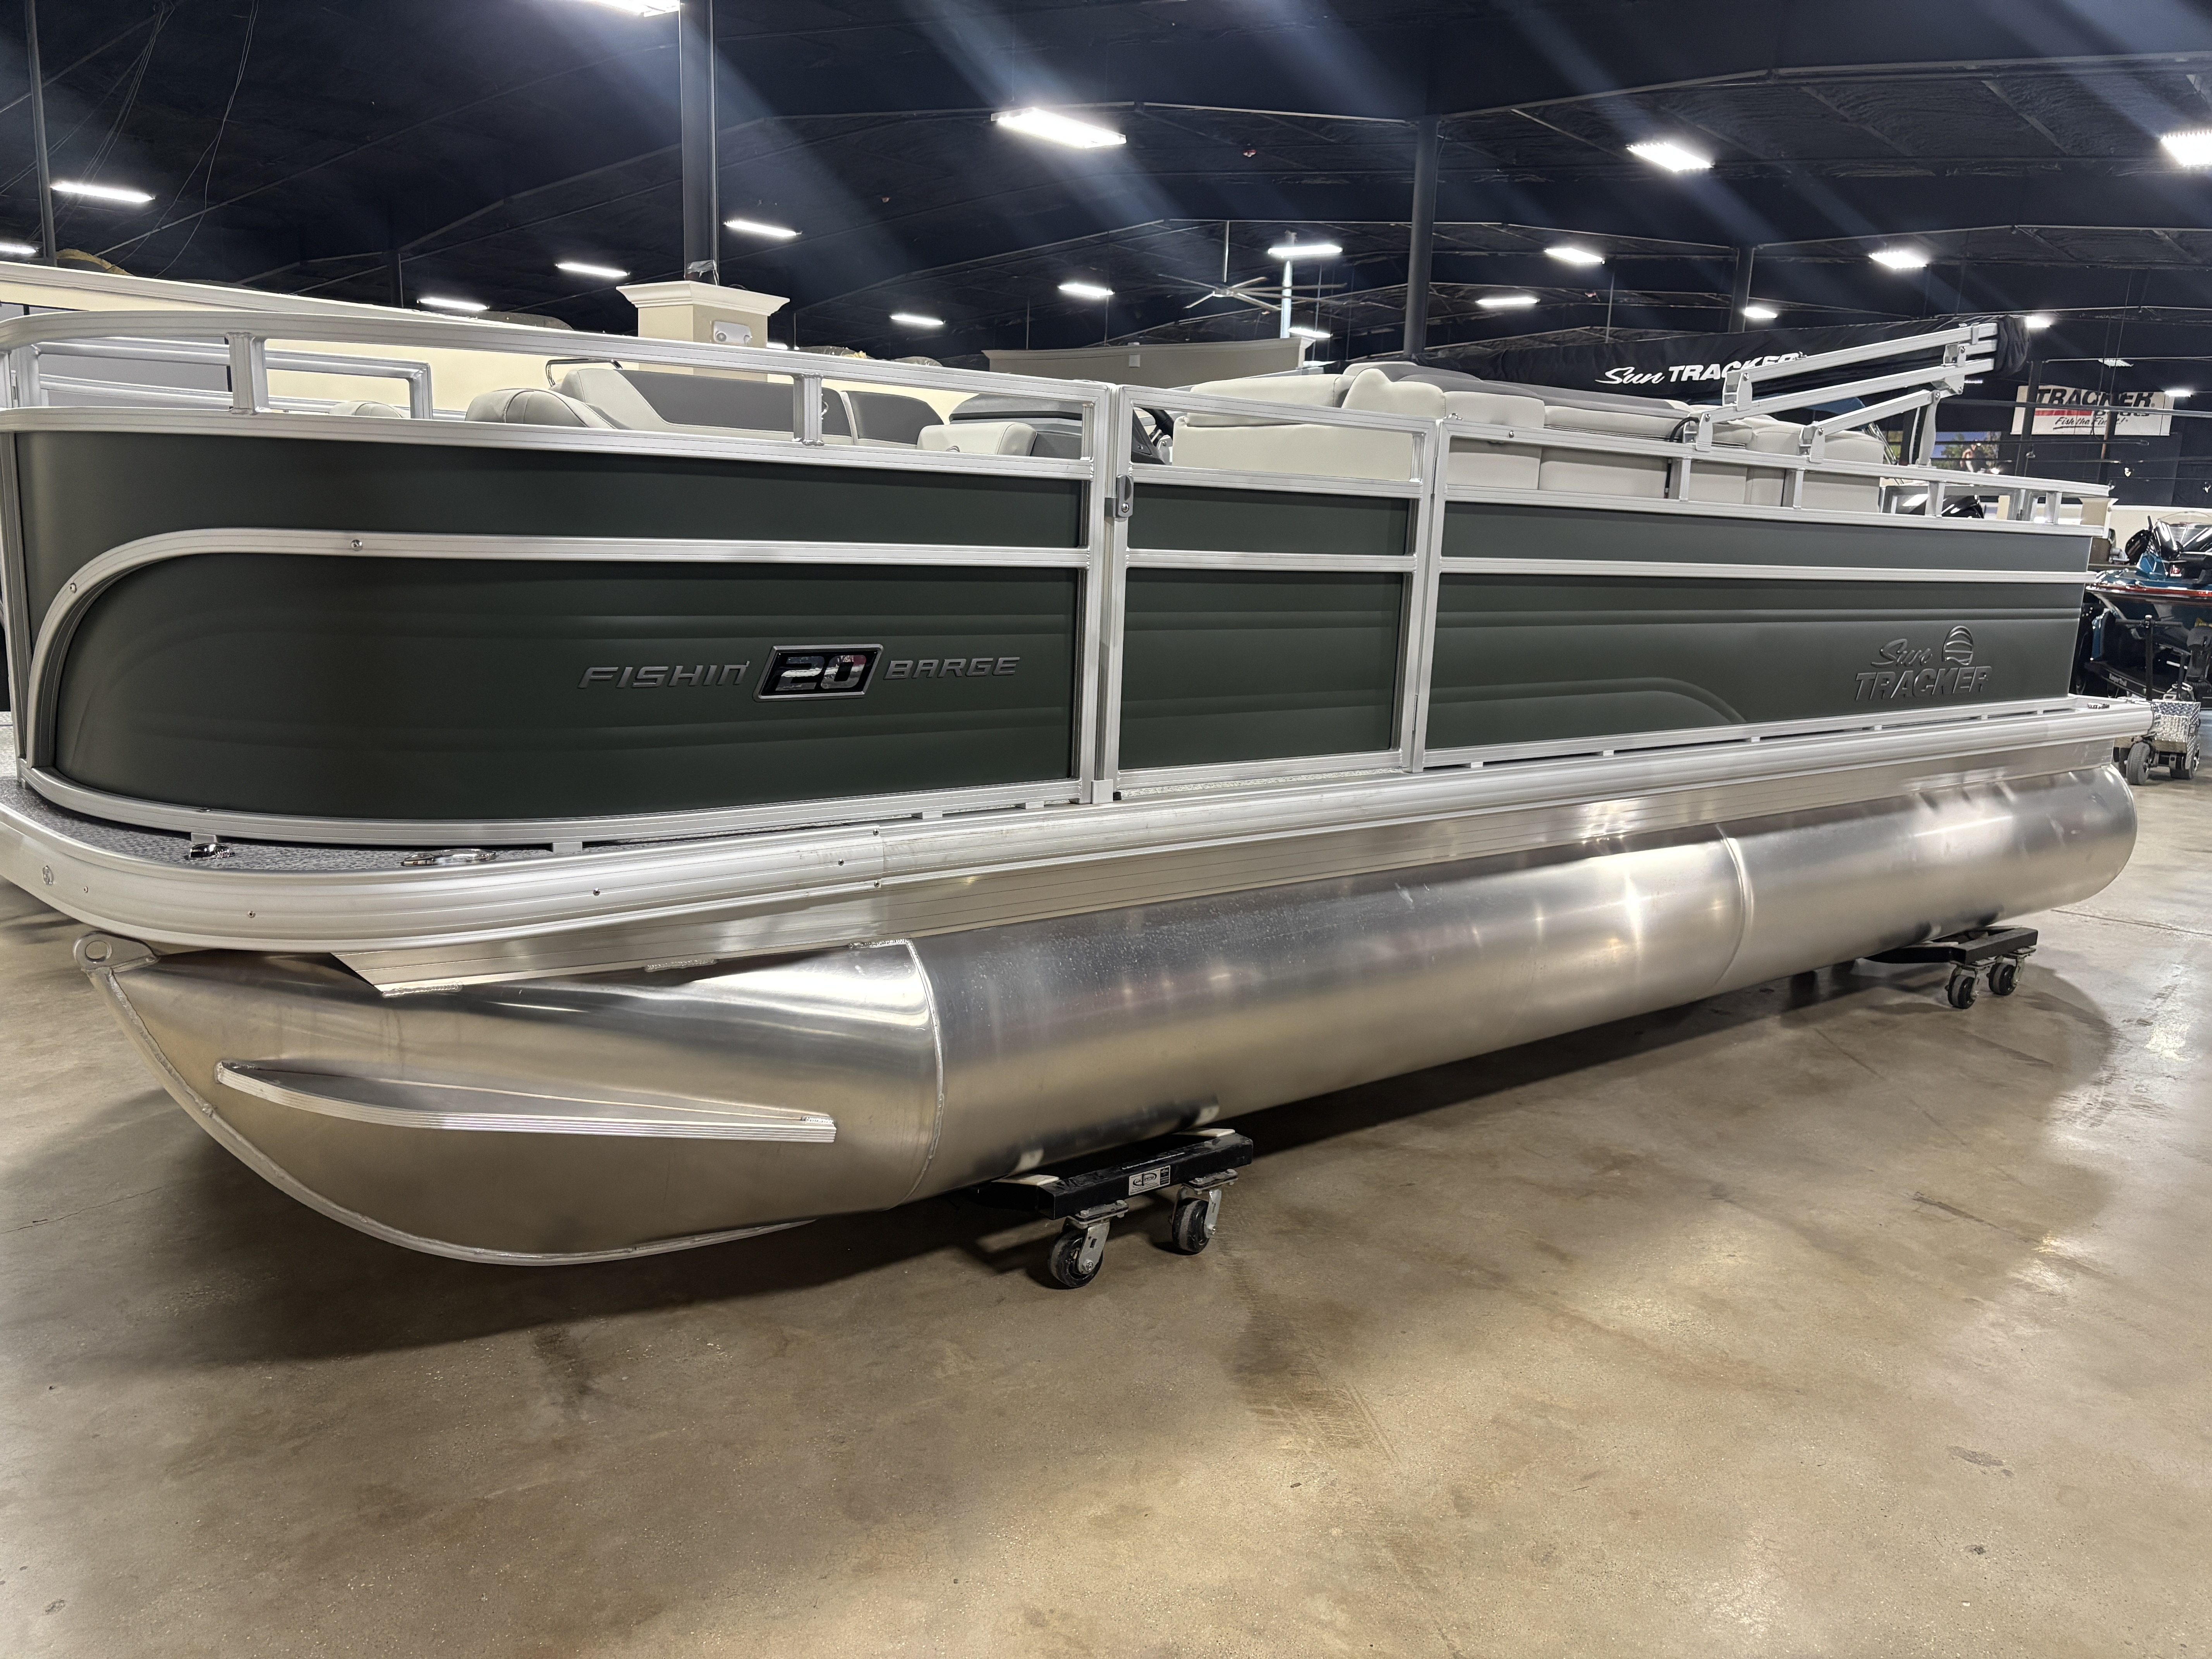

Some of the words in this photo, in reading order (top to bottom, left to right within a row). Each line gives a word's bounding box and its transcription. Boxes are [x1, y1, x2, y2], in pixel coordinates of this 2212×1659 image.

[1595, 366, 1665, 384] Sun
[2055, 417, 2075, 425] Fish
[1871, 639, 1933, 667] Sun
[775, 655, 867, 691] 20
[883, 656, 1021, 680] BARGE
[1855, 666, 1992, 701] TRACKER
